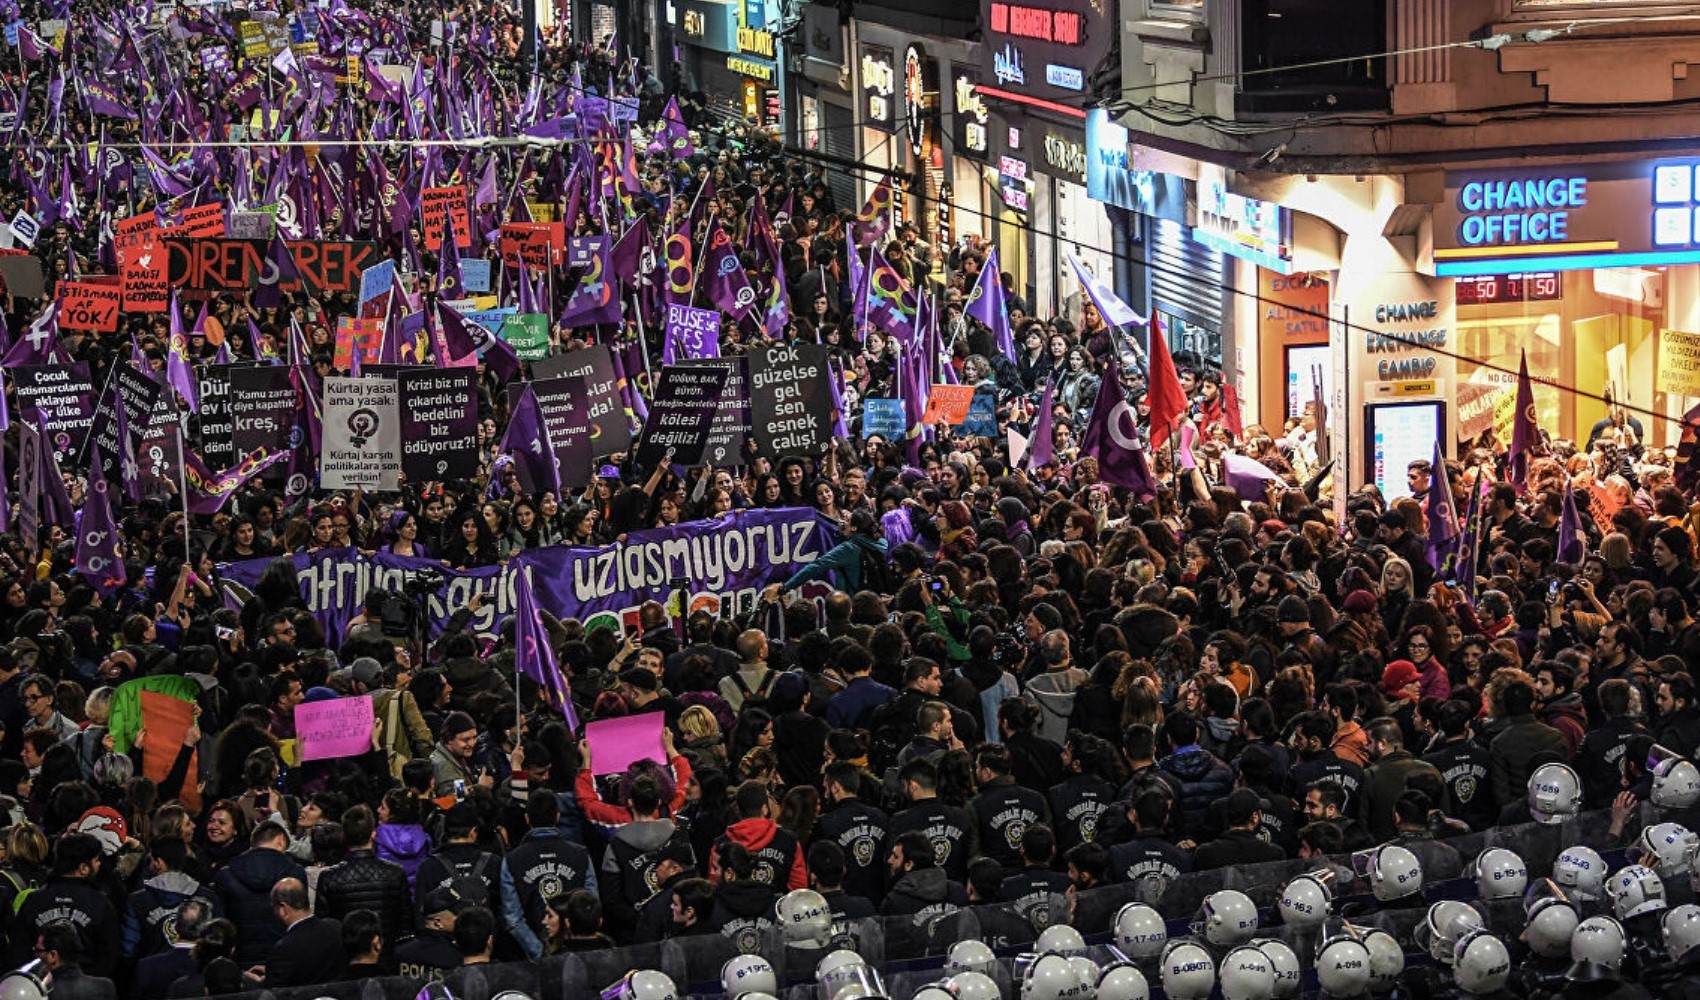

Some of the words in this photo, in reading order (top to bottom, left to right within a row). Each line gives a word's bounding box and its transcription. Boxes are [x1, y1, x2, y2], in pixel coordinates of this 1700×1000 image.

[1460, 178, 1588, 212] CHANGE
[1460, 211, 1569, 245] OFFICE
[1375, 301, 1438, 323] CHANGE
[1366, 329, 1447, 353] EXCHANGE
[766, 347, 799, 364] Çok
[1378, 357, 1437, 380] CAMBIO
[34, 370, 70, 384] Çocuk
[406, 379, 429, 391] Krizi
[431, 377, 451, 389] biz
[453, 376, 469, 388] mi
[753, 366, 818, 388] güzelse
[327, 383, 363, 397] Kürtaj
[365, 383, 397, 396] yasal
[774, 382, 801, 401] gel
[35, 395, 79, 407] aklayan
[233, 400, 254, 412] diye
[328, 397, 354, 406] ama
[357, 394, 395, 408] yasak:
[407, 395, 453, 410] çıkardık
[454, 392, 469, 404] da
[775, 400, 805, 415] sen
[413, 407, 465, 422] bedelini
[659, 413, 702, 426] kölesi
[430, 424, 449, 436] biz
[767, 414, 818, 433] esnek
[404, 436, 476, 455] ödüyoruz?!
[649, 431, 700, 446] değiliz!
[772, 431, 816, 454] çalış!
[330, 450, 361, 461] Kürtaj
[324, 462, 379, 472] politikalara
[380, 462, 399, 471] son
[341, 472, 382, 483] verilsin!
[573, 520, 819, 602] uzlaşmıyoruz
